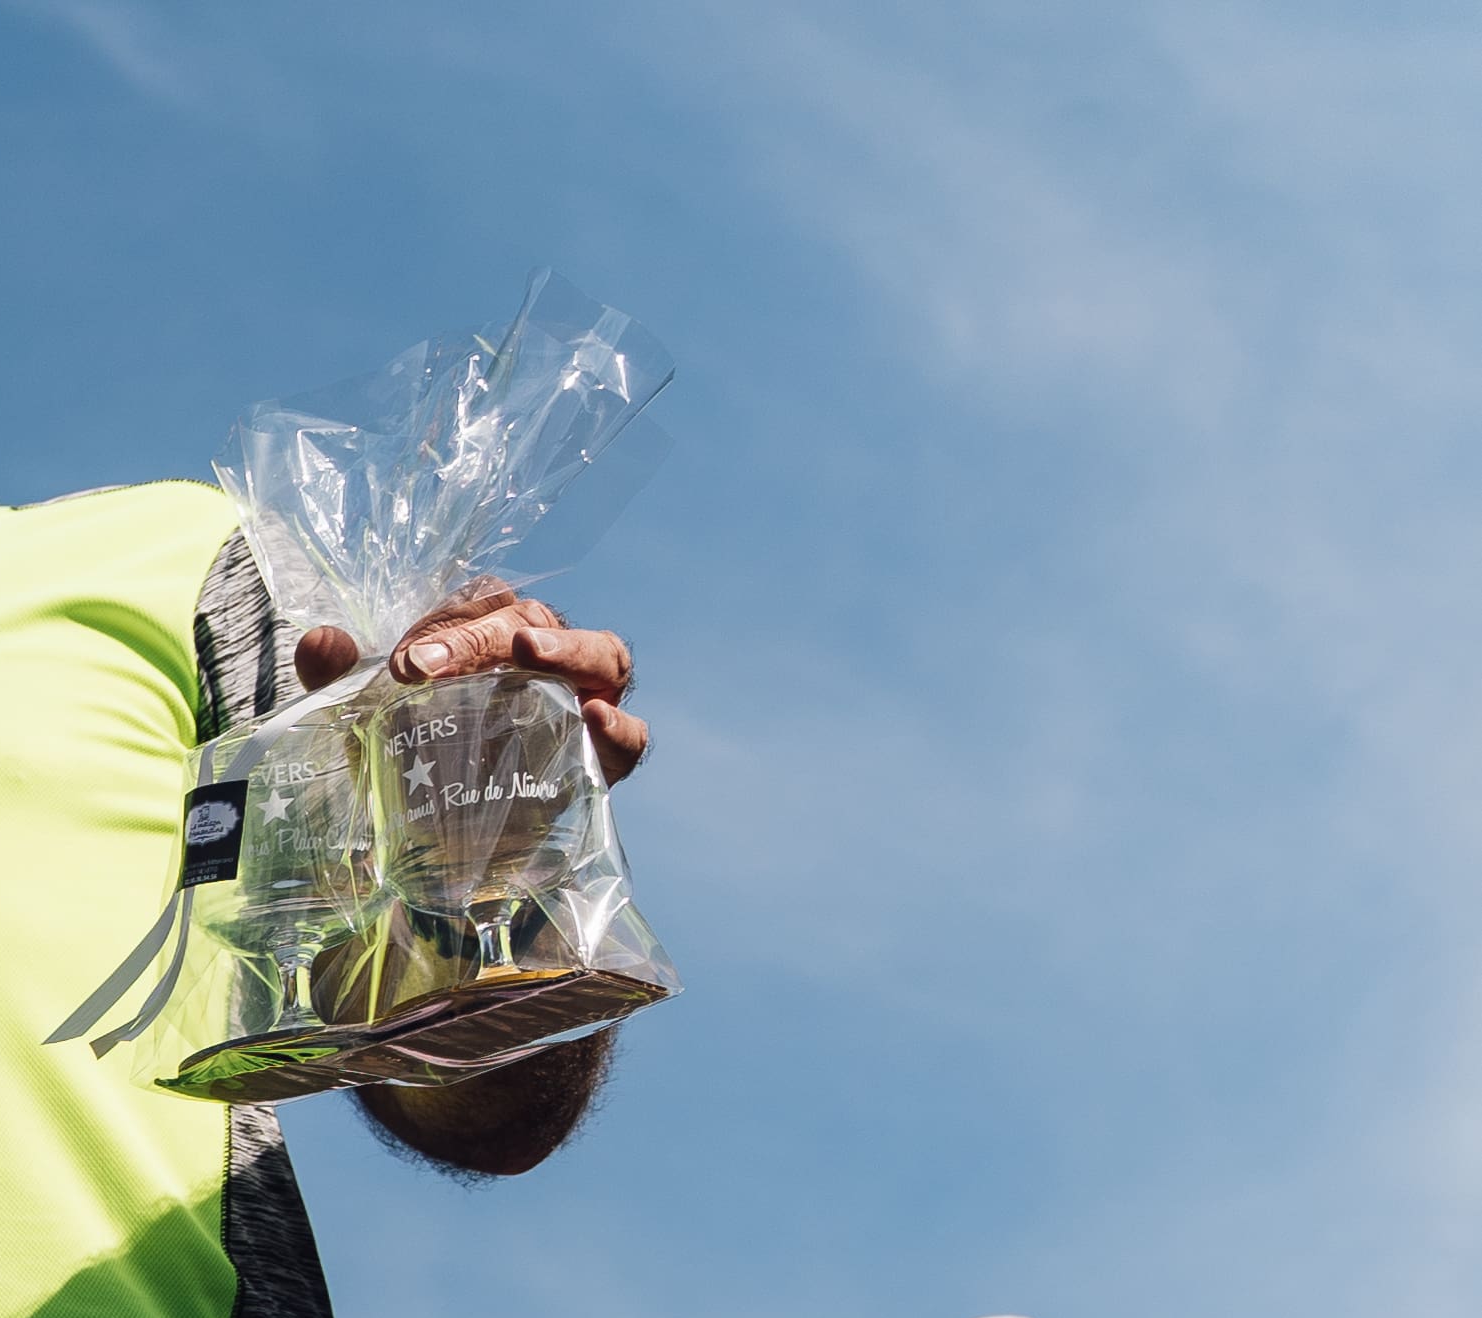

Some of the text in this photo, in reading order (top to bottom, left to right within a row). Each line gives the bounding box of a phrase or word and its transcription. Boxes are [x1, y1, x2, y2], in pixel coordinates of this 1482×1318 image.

[383, 714, 458, 762] NEVERS
[262, 761, 316, 787] VERS
[440, 781, 481, 811] Rue
[484, 775, 504, 801] de
